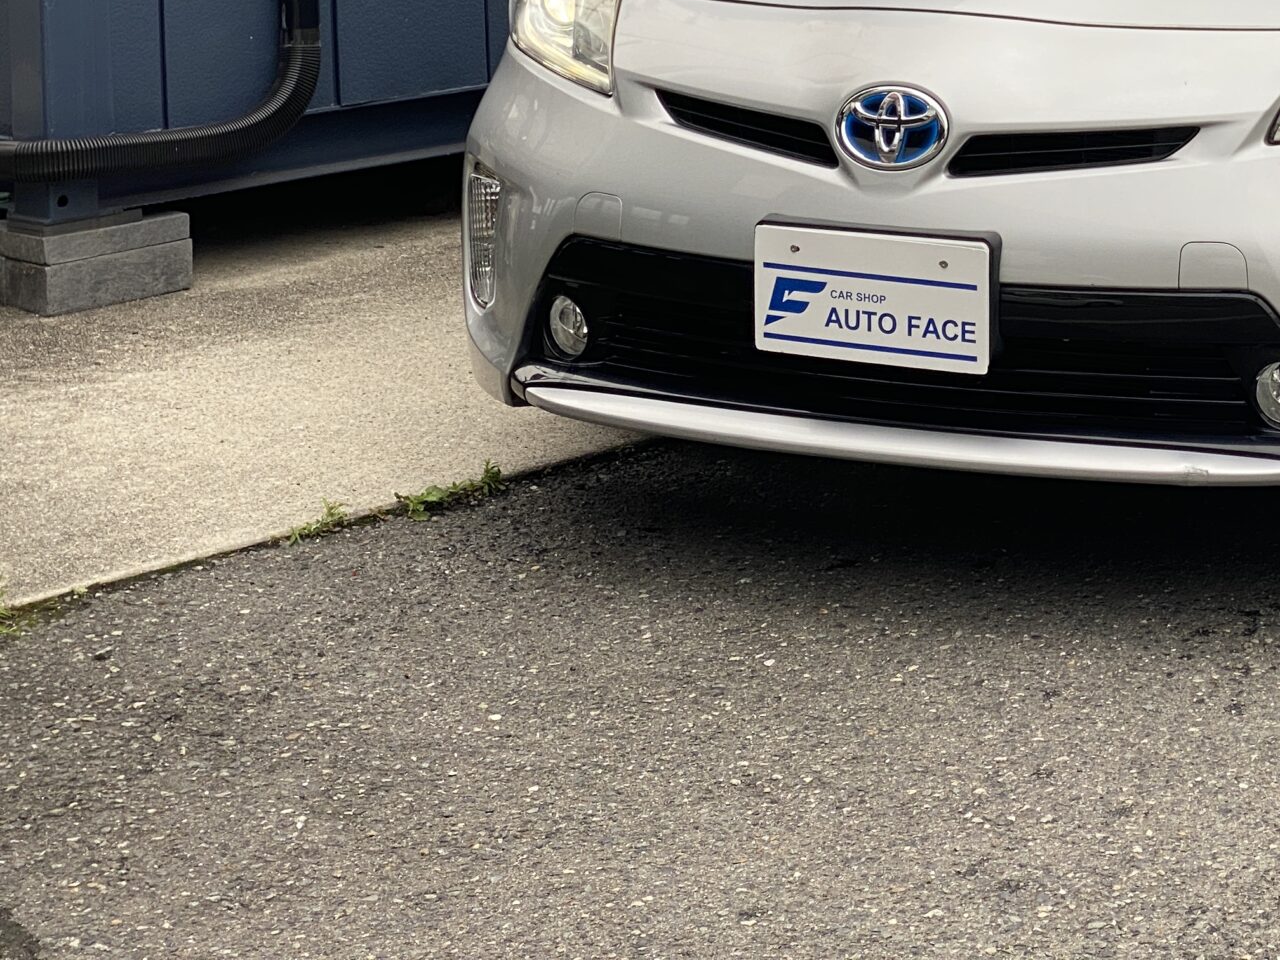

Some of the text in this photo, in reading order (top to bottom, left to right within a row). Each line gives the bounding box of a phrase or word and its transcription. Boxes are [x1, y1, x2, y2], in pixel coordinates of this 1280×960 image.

[830, 289, 887, 304] CAR SHOP
[824, 307, 977, 344] AUTO FACE
